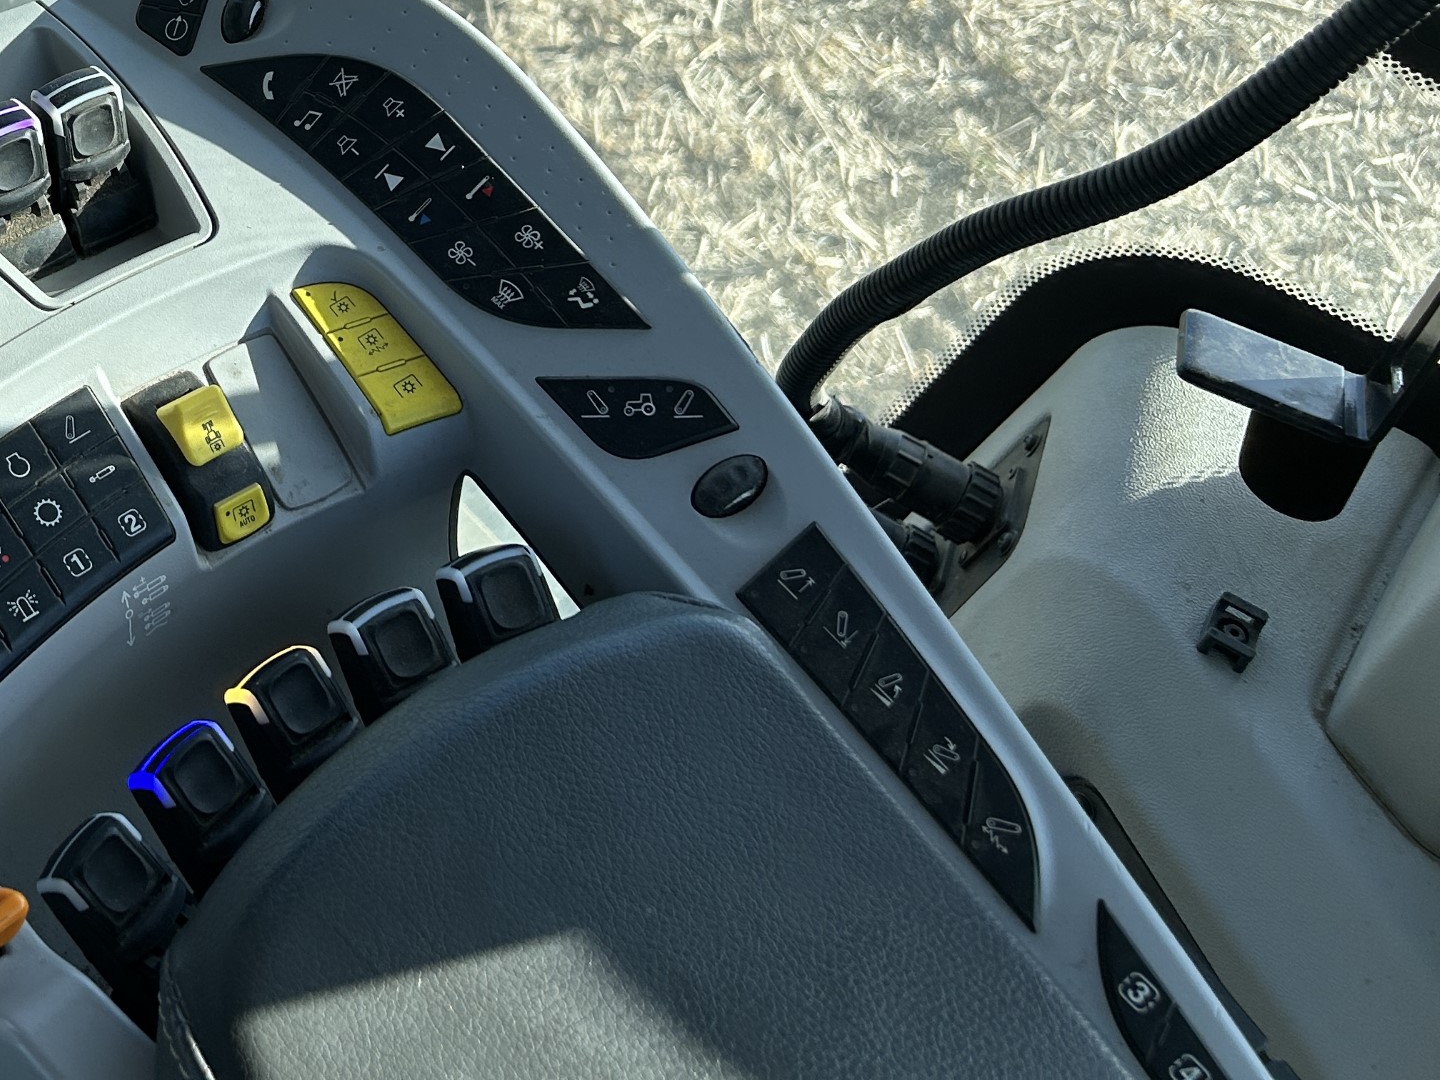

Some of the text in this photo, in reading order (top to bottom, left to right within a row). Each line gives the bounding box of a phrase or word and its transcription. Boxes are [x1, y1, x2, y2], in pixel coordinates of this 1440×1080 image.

[125, 513, 142, 533] 2
[239, 515, 256, 528] AUTO
[72, 553, 85, 572] 1
[1126, 981, 1151, 1003] 3
